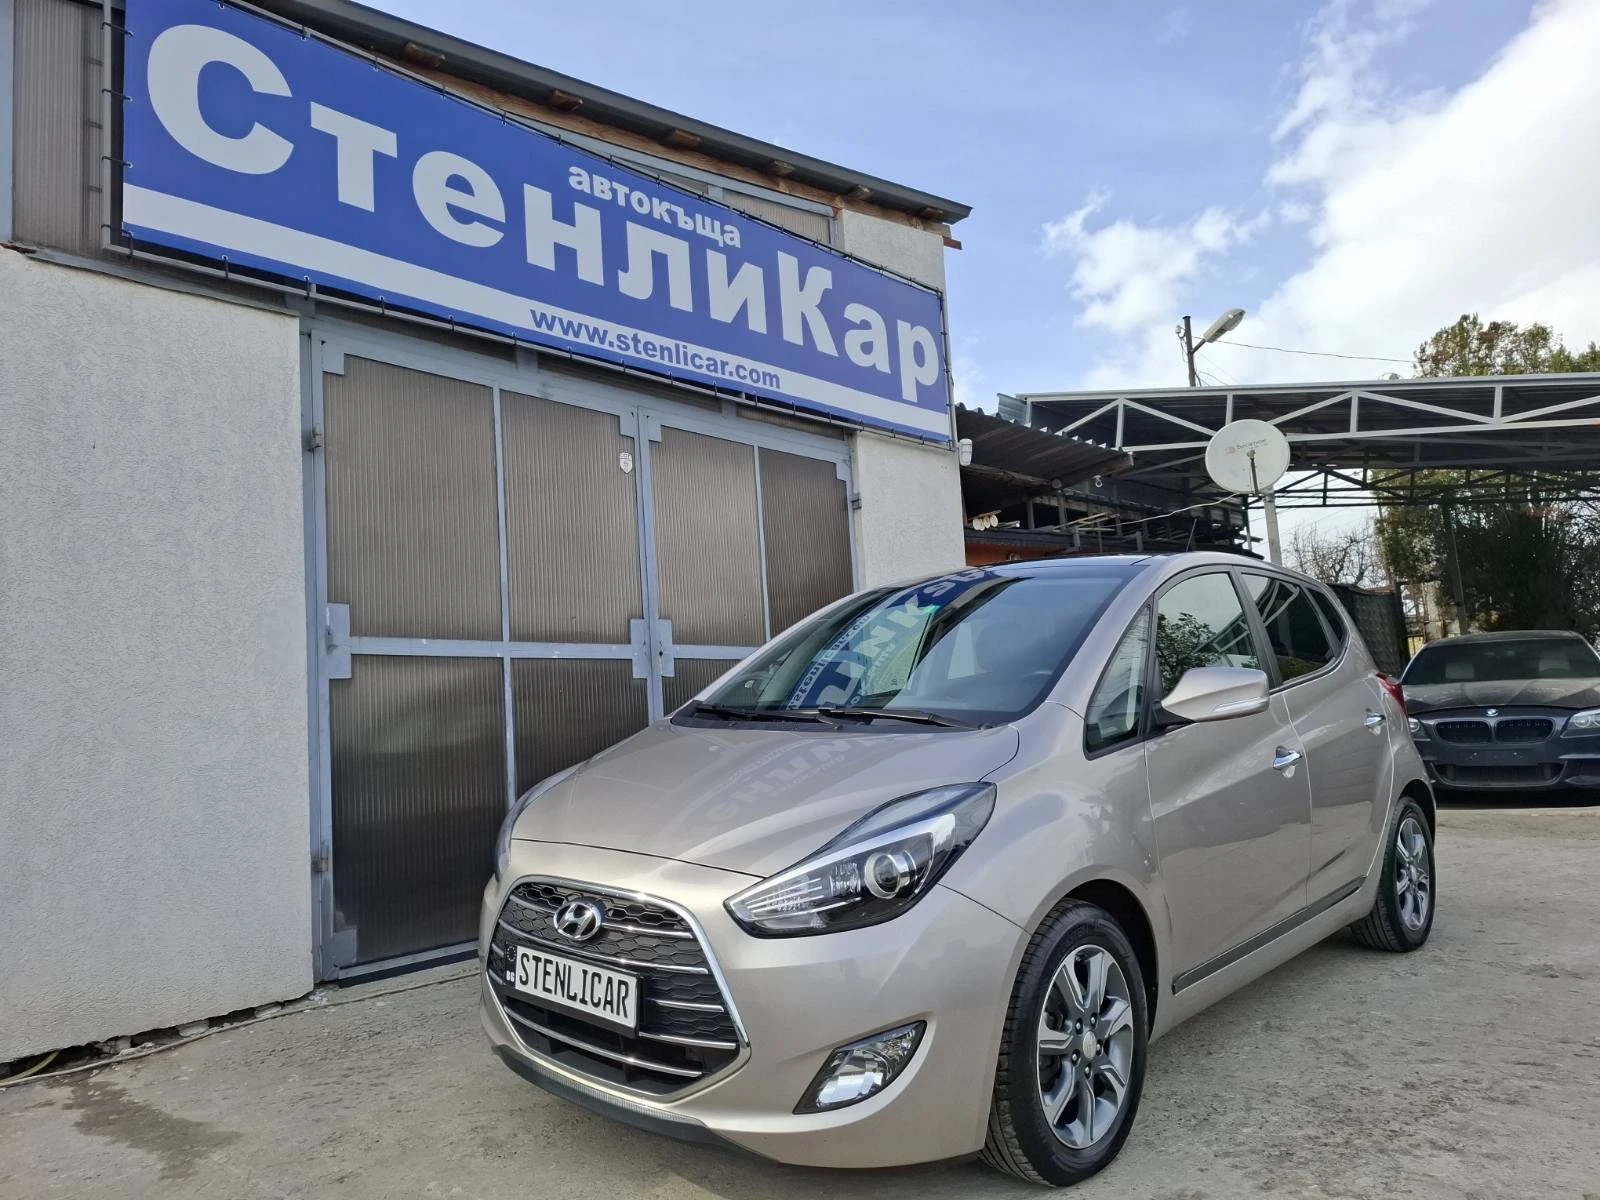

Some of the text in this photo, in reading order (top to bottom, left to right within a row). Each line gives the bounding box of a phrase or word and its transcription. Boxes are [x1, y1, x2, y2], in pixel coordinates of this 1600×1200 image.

[147, 24, 939, 403] СтенлиКар
[568, 166, 741, 248] автокъща
[530, 309, 780, 388] www.stenlicar.com
[505, 970, 515, 982] BG
[519, 952, 629, 1018] STENLICAR
